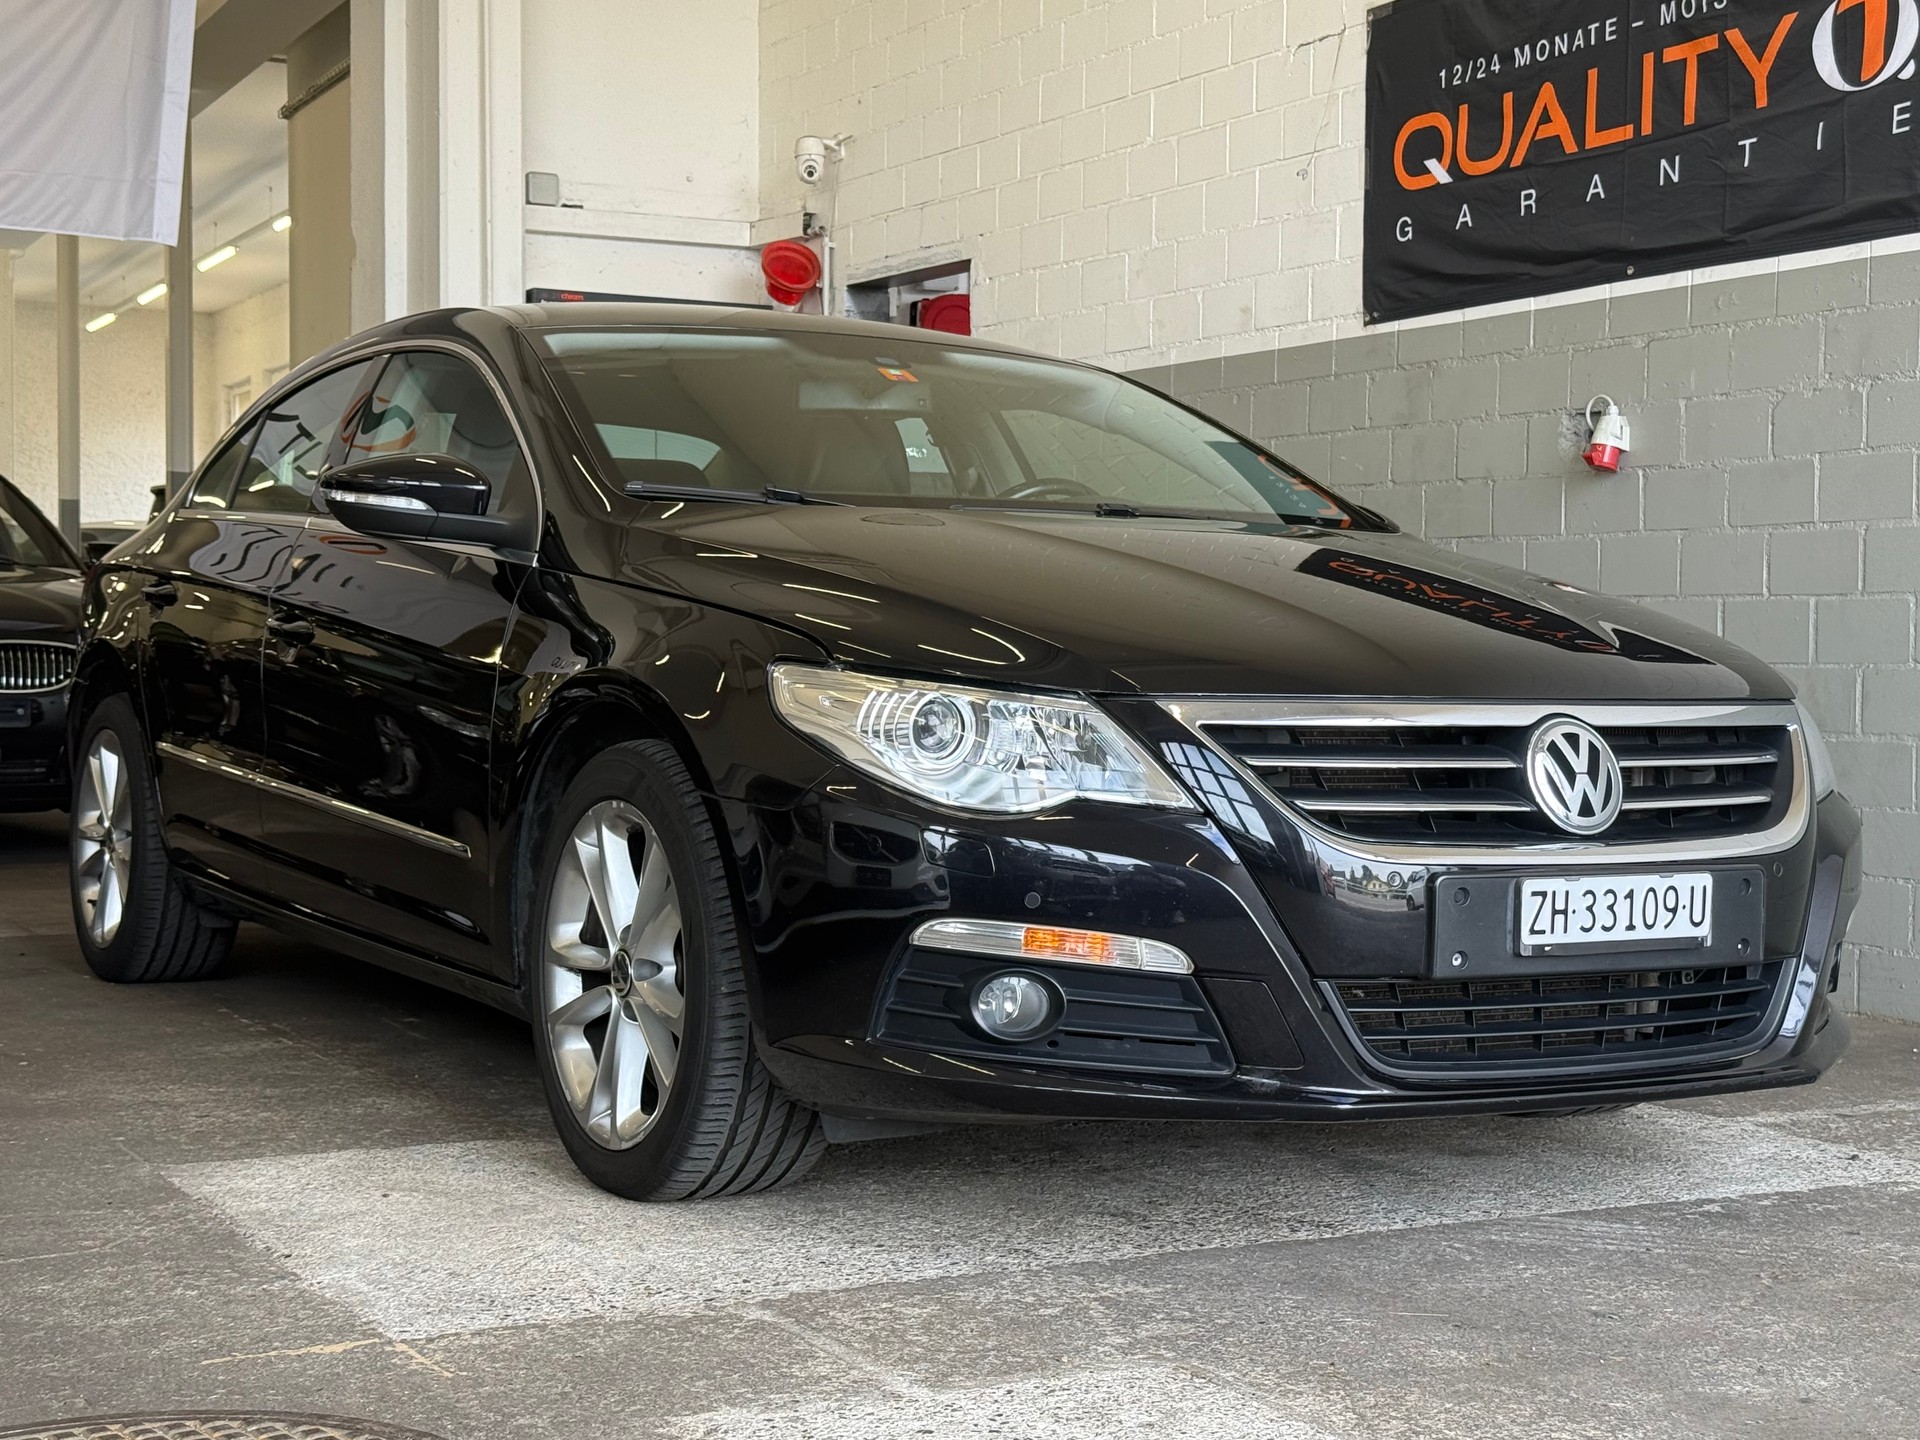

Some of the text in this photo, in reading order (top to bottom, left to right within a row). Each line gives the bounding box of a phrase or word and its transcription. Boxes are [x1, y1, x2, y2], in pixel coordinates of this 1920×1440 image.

[1393, 12, 1799, 191] QUALITY
[1439, 56, 1501, 90] 12/24
[1514, 17, 1618, 68] MONATE
[1395, 101, 1912, 242] GARANTIE
